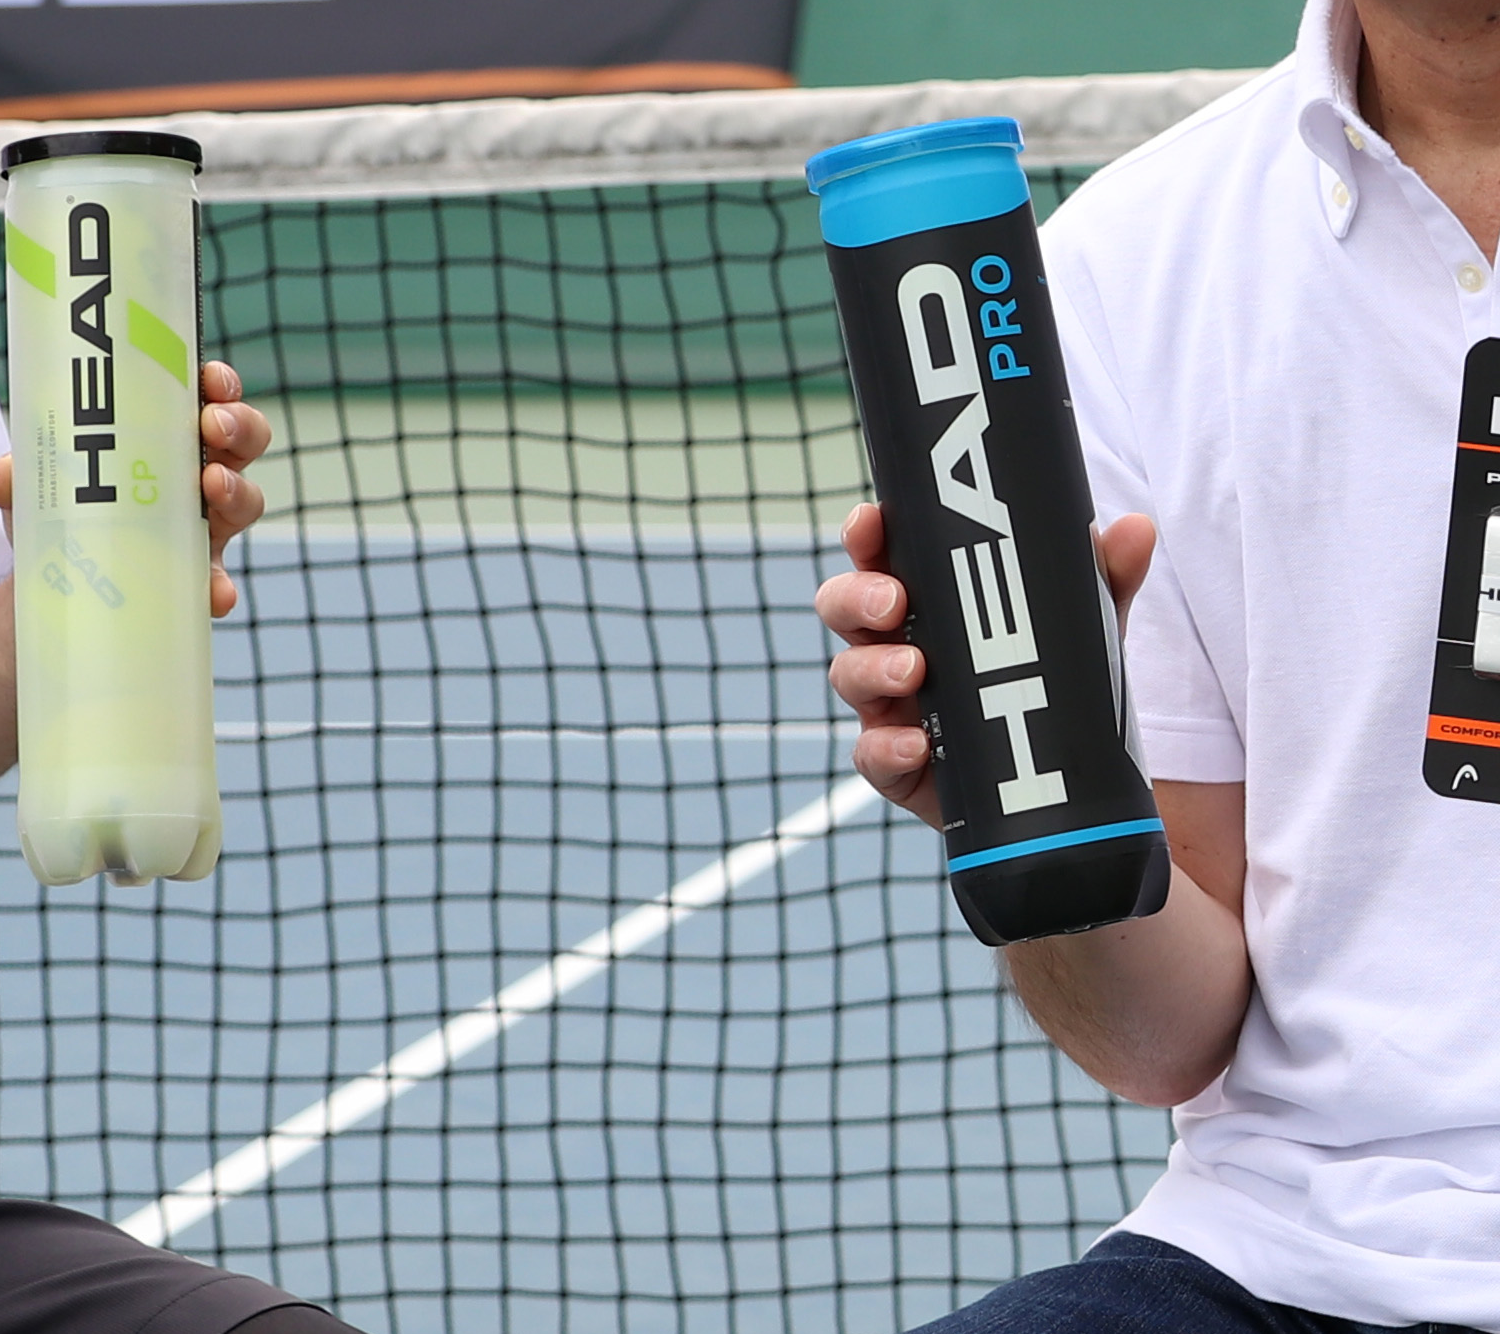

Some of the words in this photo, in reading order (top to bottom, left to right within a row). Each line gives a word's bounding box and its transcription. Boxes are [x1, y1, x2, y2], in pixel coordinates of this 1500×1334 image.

[68, 200, 118, 504] HEAD
[970, 253, 1032, 383] PRO
[47, 410, 56, 447] COMFORT
[132, 460, 158, 505] CP
[897, 262, 1070, 817] HEAD
